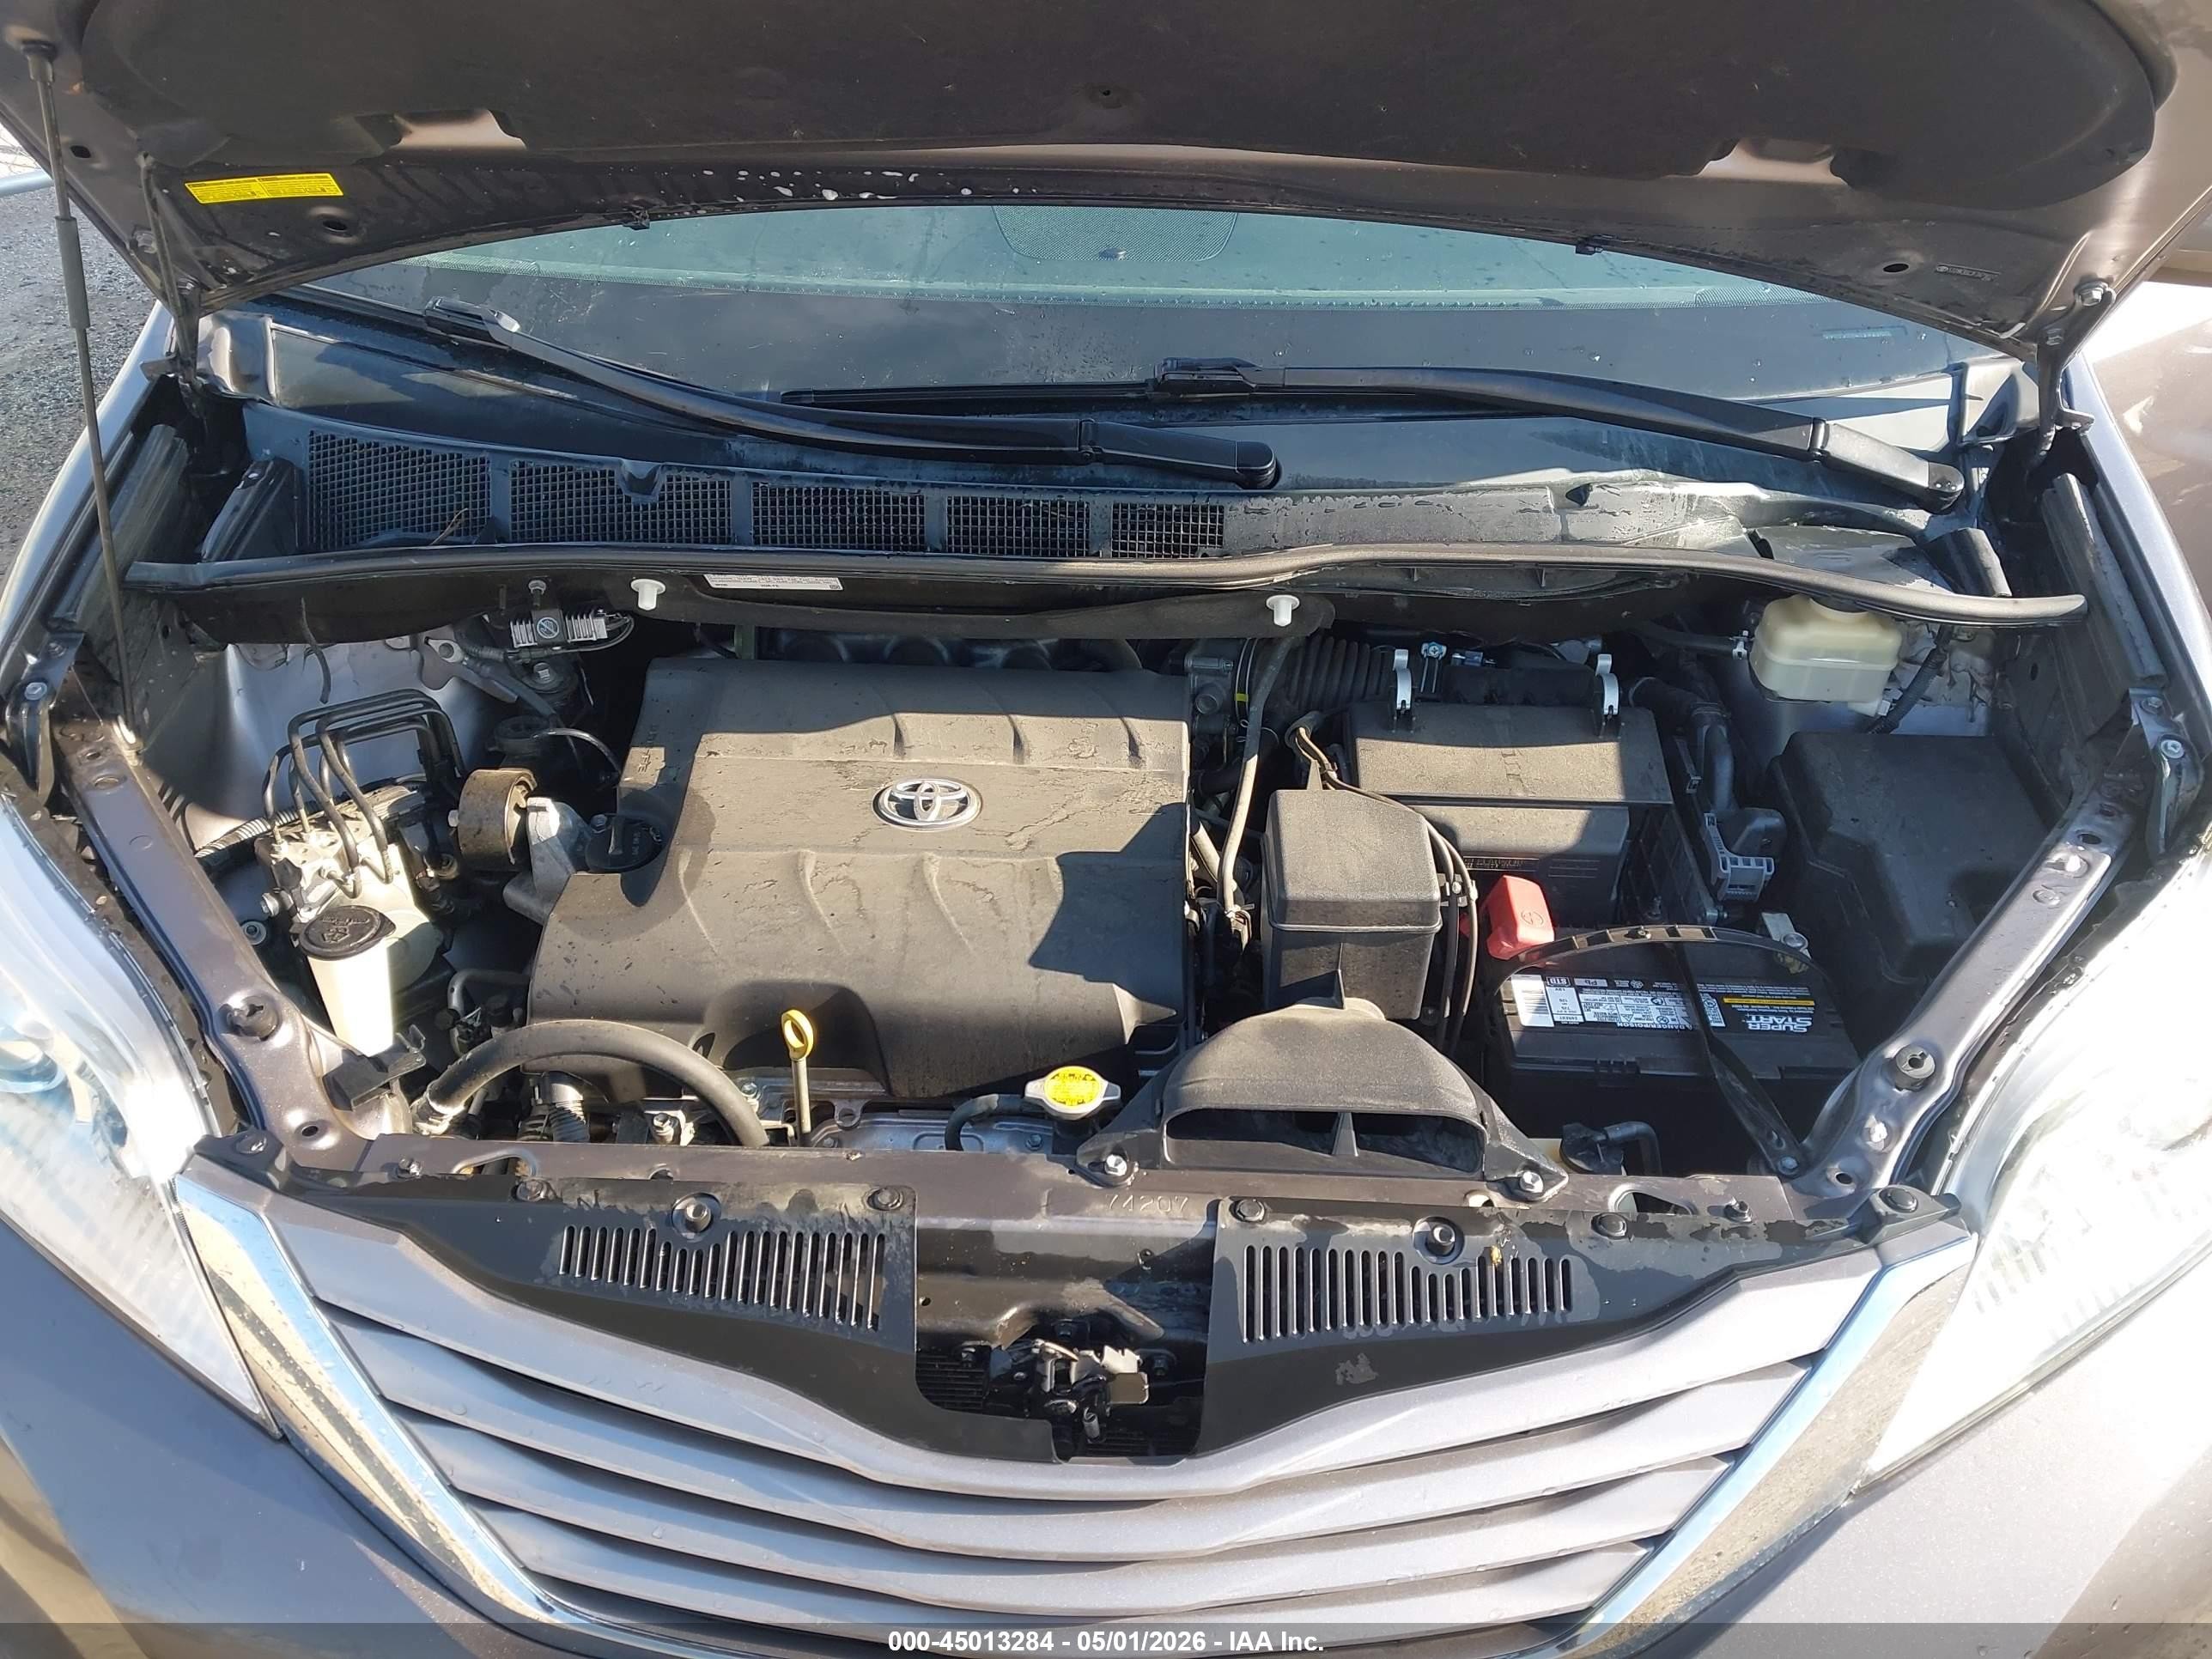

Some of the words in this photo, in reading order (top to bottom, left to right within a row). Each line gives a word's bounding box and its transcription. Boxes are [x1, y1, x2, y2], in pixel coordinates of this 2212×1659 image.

[1746, 1015, 1813, 1026] START
[1616, 1022, 1686, 1030] DANGER/POISON
[1747, 1023, 1808, 1032] SUPER
[1106, 1194, 1189, 1212] 74207
